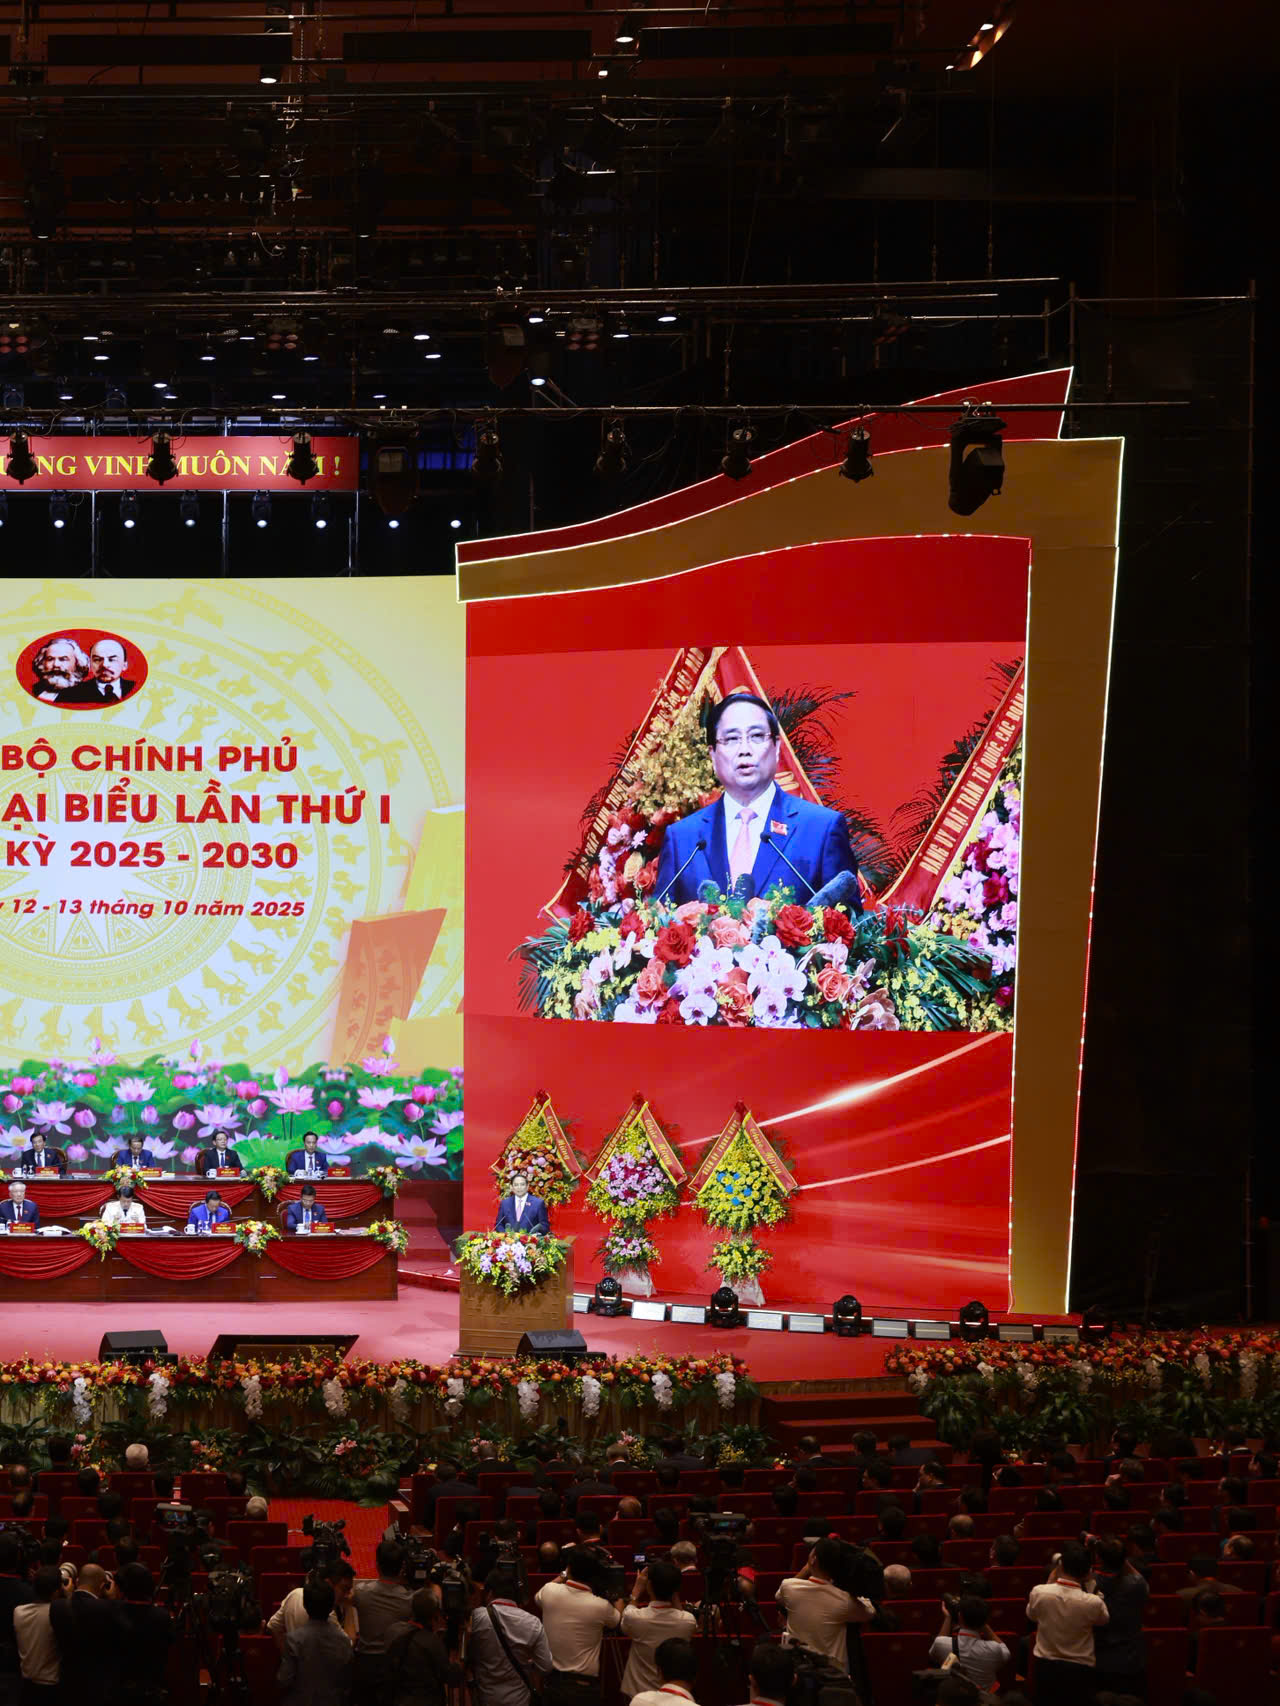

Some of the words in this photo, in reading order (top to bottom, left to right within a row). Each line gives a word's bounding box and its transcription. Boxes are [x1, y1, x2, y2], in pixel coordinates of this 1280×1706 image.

[84, 455, 154, 476] VINH
[2, 737, 58, 778] BỘ
[71, 738, 203, 772] CHÍNH
[218, 736, 297, 773] PHỦ
[65, 777, 158, 824] BIỂU
[176, 779, 261, 824] LẦN
[276, 785, 366, 824] THỨ
[380, 794, 390, 824] I
[6, 833, 56, 866] KỲ
[70, 841, 166, 868] 2025
[202, 842, 298, 869] 2030
[13, 898, 37, 914] 12
[59, 899, 83, 915] 13
[90, 899, 155, 919] tháng
[164, 900, 189, 915] 10
[195, 900, 245, 916] năm
[251, 901, 305, 917] 2025
